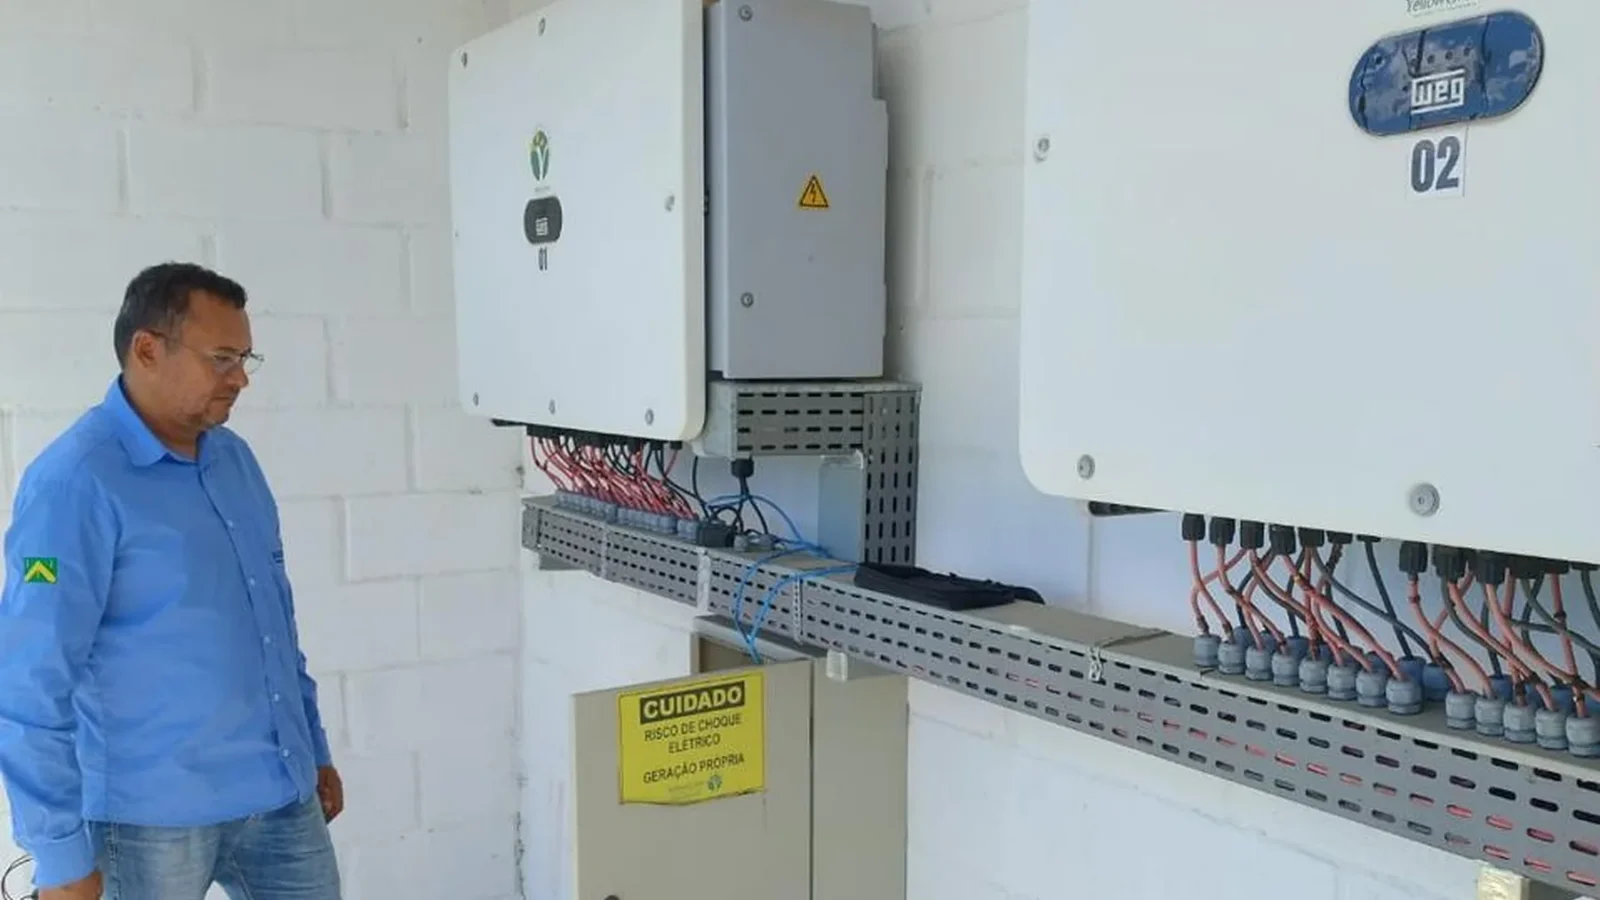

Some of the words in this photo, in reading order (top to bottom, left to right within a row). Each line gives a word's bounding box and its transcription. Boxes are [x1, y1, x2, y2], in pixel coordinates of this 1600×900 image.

[1411, 136, 1460, 193] 02
[538, 246, 548, 271] 01
[643, 686, 742, 719] CUIDADO
[644, 724, 679, 741] RISCO
[681, 721, 696, 735] DE
[698, 713, 741, 732] CHOQUE
